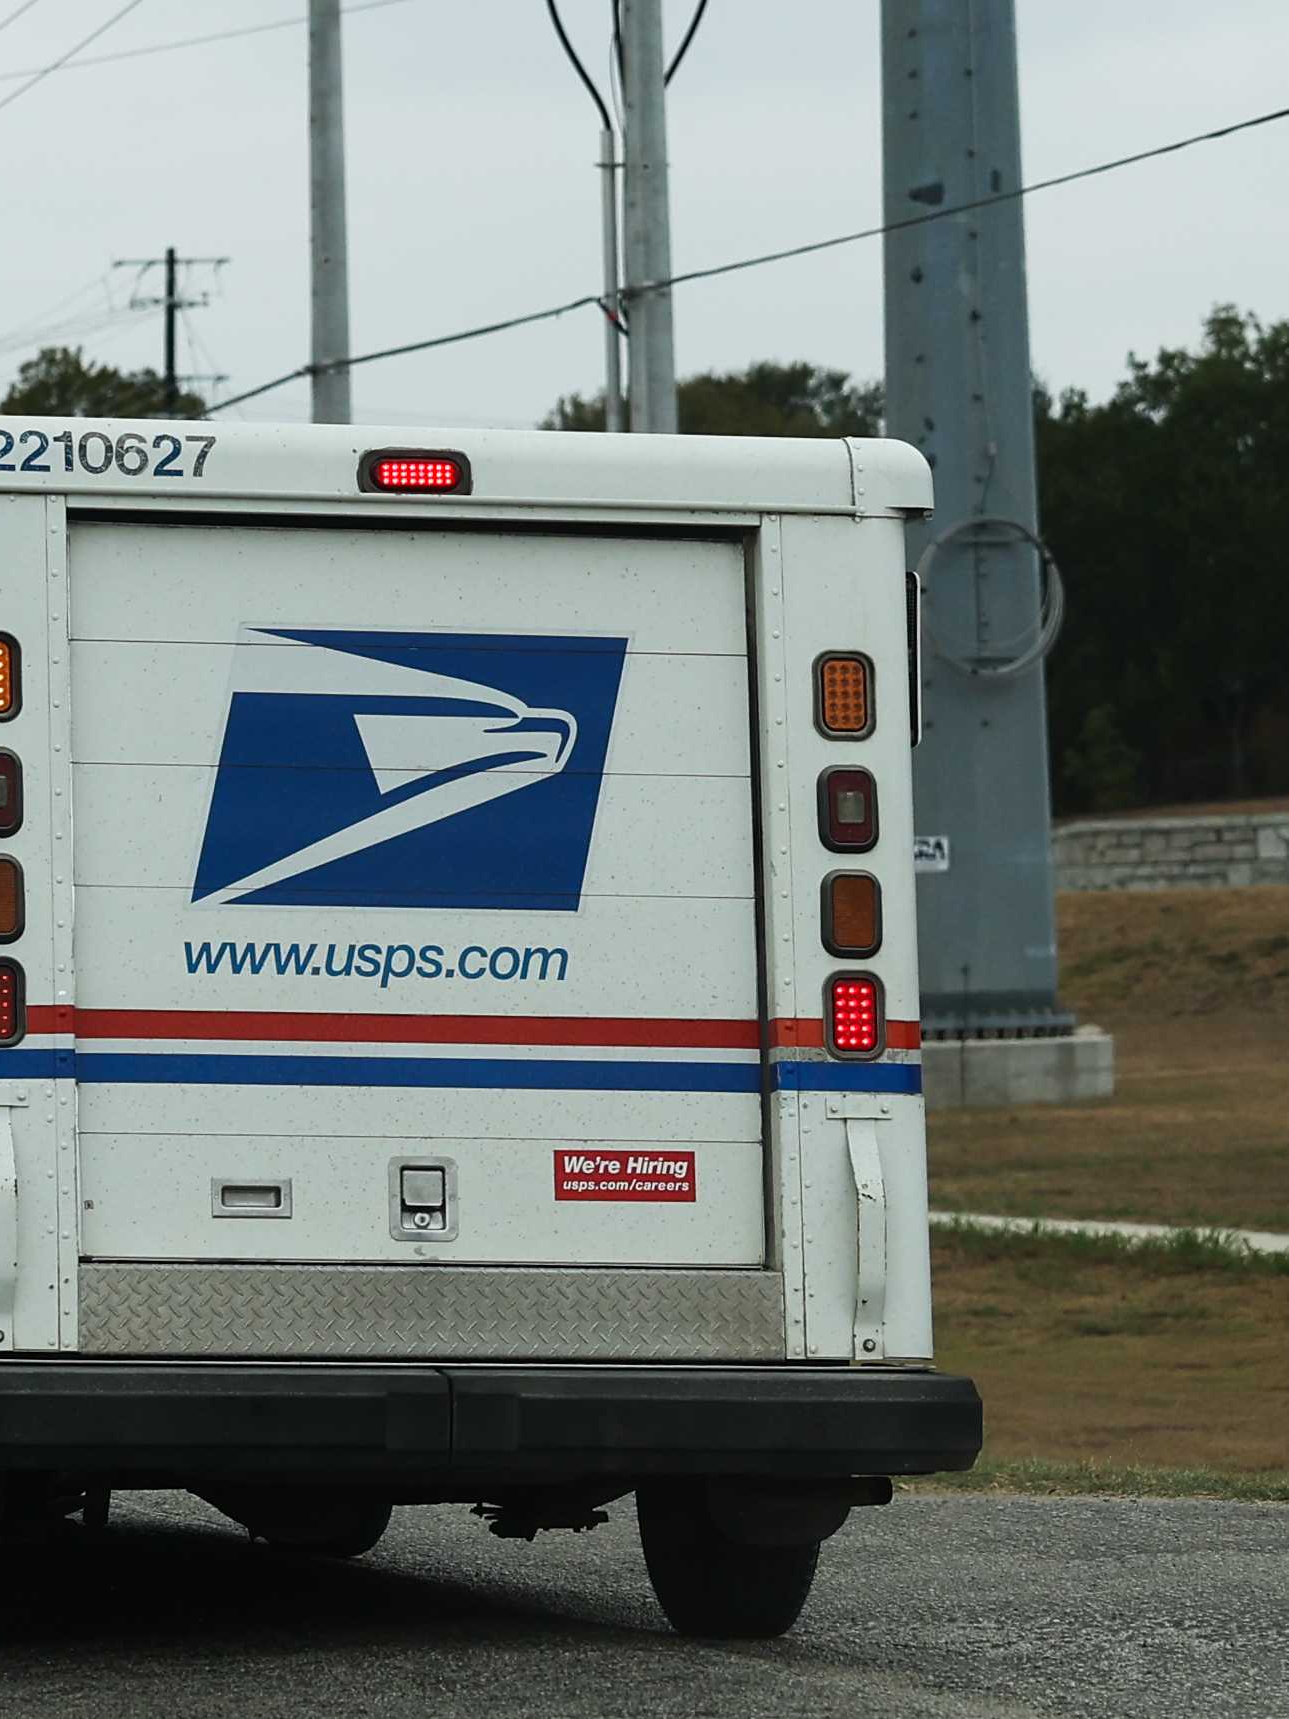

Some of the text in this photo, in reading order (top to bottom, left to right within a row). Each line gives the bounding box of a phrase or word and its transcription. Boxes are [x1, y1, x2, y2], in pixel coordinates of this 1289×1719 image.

[183, 941, 569, 988] www.usps.com
[563, 1155, 688, 1178] We're Hiring
[563, 1179, 689, 1192] usps.com/careers
